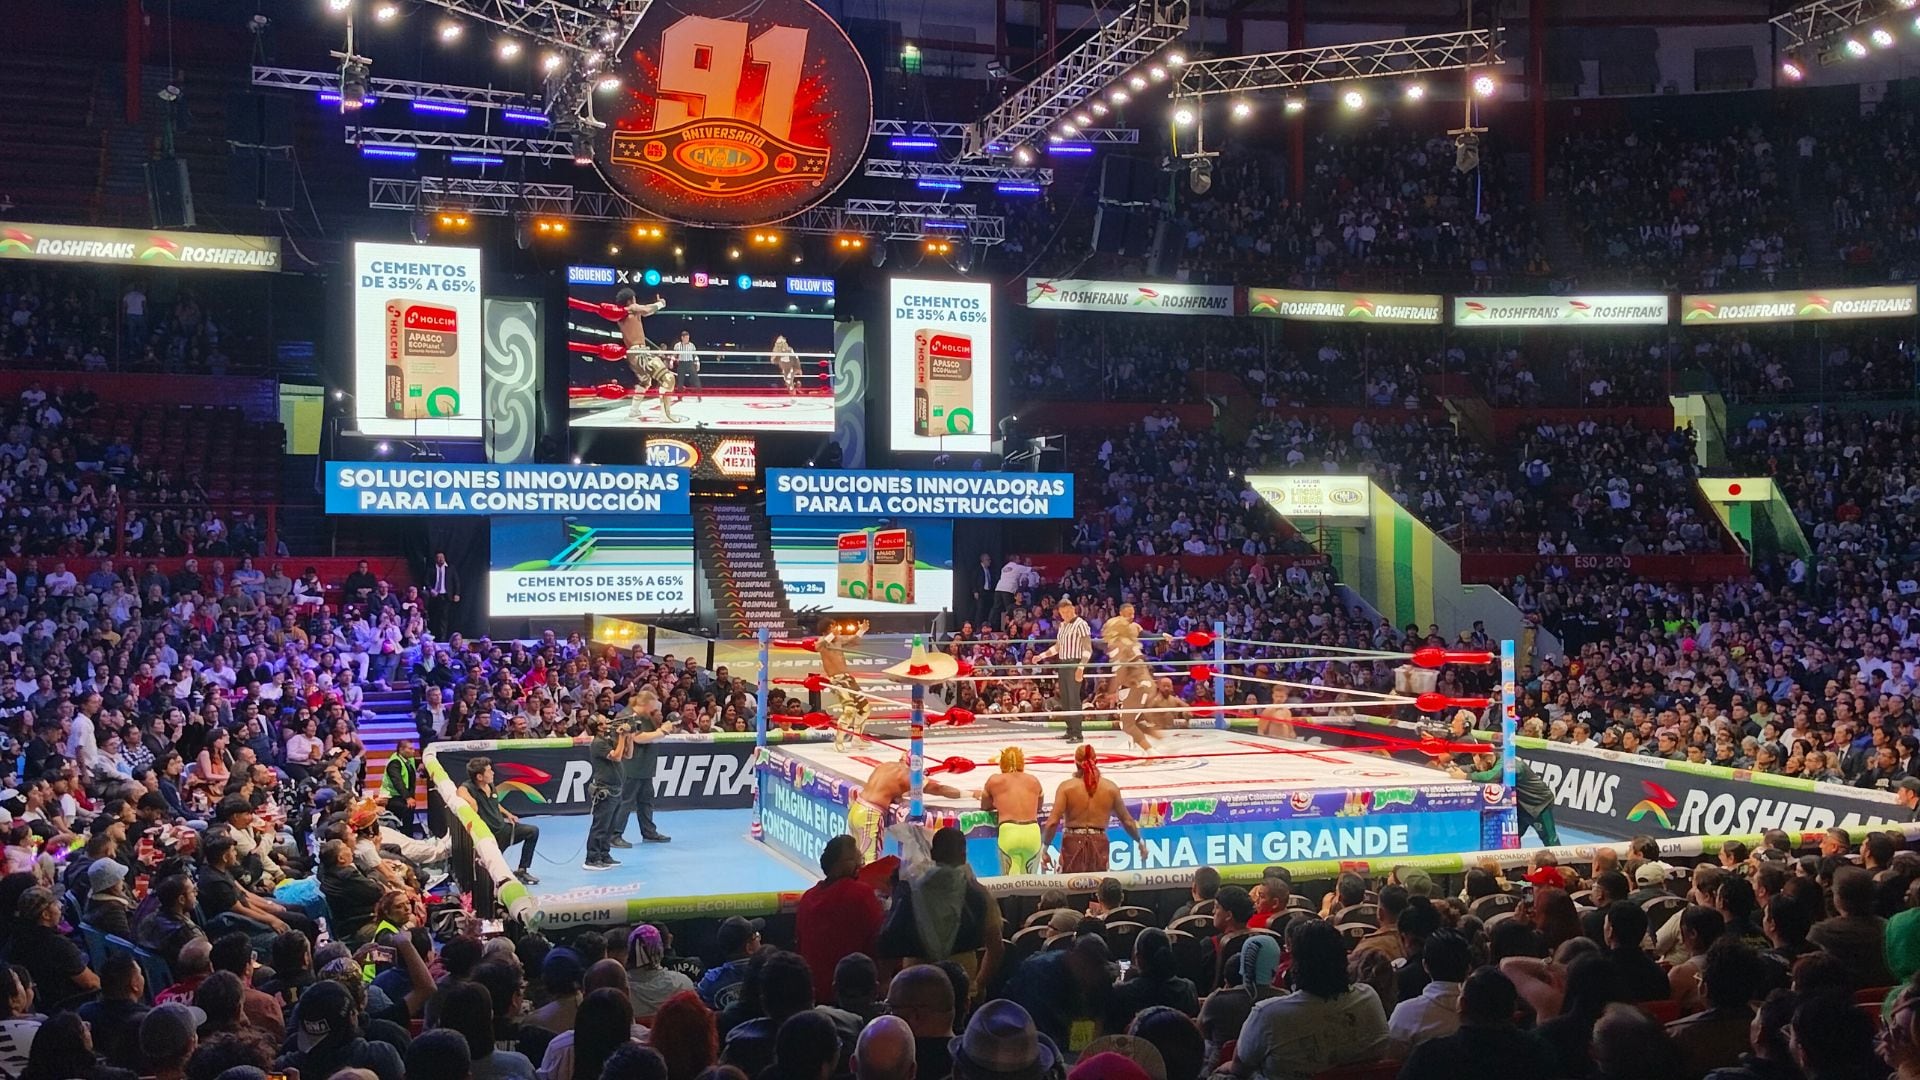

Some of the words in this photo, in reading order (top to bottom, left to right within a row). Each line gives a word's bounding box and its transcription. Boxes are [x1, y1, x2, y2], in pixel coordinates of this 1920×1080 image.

[653, 15, 809, 140] 91
[681, 127, 767, 148] ANIVERSARIO
[693, 147, 747, 168] CMLL
[36, 239, 135, 259] ROSHFRANS
[181, 246, 278, 266] ROSHFRANS
[371, 261, 467, 278] CEMENTOS
[569, 266, 613, 282] SÍGUENOS
[362, 275, 385, 288] DE
[388, 277, 423, 290] 35%
[426, 278, 439, 291] A
[441, 279, 476, 293] 65%
[790, 280, 820, 292] FOLLOW
[822, 281, 833, 293] US
[903, 295, 980, 310] CEMENTOS
[1059, 290, 1129, 306] ROSHFRANS
[1161, 294, 1228, 310] ROSHFRANS
[1718, 303, 1796, 319] ROSHFRANS
[1832, 298, 1911, 314] ROSHFRANS
[896, 308, 914, 320] DE
[917, 309, 945, 321] 35%
[947, 311, 957, 322] A
[960, 311, 987, 323] 65%
[1279, 301, 1345, 317] ROSHFRANS
[1374, 305, 1438, 321] ROSHFRANS
[1489, 305, 1560, 319] ROSHFRANS
[1593, 304, 1664, 318] ROSHFRANS
[420, 315, 456, 327] HOLCIM
[390, 319, 398, 360] HOLCIM
[408, 332, 443, 343] APASCO
[942, 344, 970, 354] HOLCIM
[932, 358, 960, 369] APASCO
[646, 445, 686, 467] MLL
[724, 445, 755, 455] AREN
[339, 469, 500, 489] SOLUCIONES
[505, 471, 680, 491] INNOVADORAS
[777, 475, 913, 494] SOLUCIONES
[916, 477, 1065, 496] INNOVADORAS
[361, 491, 429, 510] PARA
[435, 492, 467, 511] LA
[470, 490, 661, 512] CONSTRUCCIÓN
[795, 496, 852, 514] PARA
[857, 496, 884, 514] LA
[887, 494, 1049, 515] CONSTRUCCIÓN
[518, 576, 594, 588] CEMENTOS
[596, 576, 614, 588] DE
[617, 576, 644, 588] 35%
[646, 576, 656, 587] A
[657, 575, 684, 587] 65%
[800, 584, 806, 594] y
[506, 592, 557, 603] MENOS
[559, 591, 634, 603] EMISIONES
[636, 591, 655, 603] DE
[657, 591, 684, 602] CO2
[752, 630, 788, 638] ROFRANS
[774, 783, 814, 827] IMAGINA
[814, 802, 828, 835] EN
[761, 807, 814, 860] CONSTRUYE
[1207, 831, 1258, 866] EN
[1261, 824, 1409, 861] GRANDE
[1014, 880, 1048, 889] OFICIAL
[1048, 880, 1064, 888] DEL
[1145, 873, 1196, 886] HOLCIM
[549, 908, 610, 924] HOLCIM
[639, 904, 695, 917] CEMENTOS
[697, 899, 765, 912] ECOPlanet
